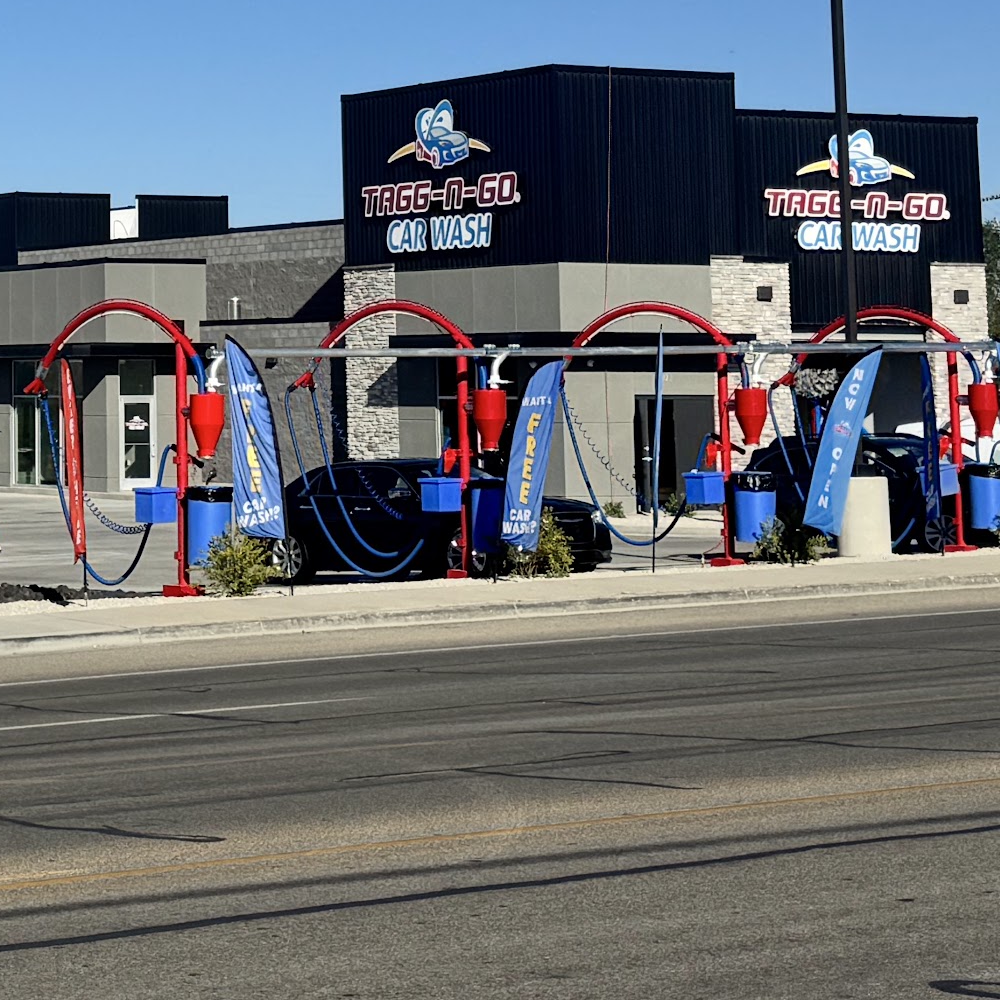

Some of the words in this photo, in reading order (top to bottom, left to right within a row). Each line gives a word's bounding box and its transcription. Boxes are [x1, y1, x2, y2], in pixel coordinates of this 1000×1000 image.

[362, 171, 519, 217] TAGG-N-GO
[387, 218, 427, 253] CAR
[430, 212, 492, 250] WASH
[798, 221, 842, 250] CAR
[852, 222, 921, 252] WASH
[845, 368, 864, 411] NOW
[519, 412, 542, 505] FREE
[817, 447, 843, 509] OPEN
[509, 508, 532, 522] CAR
